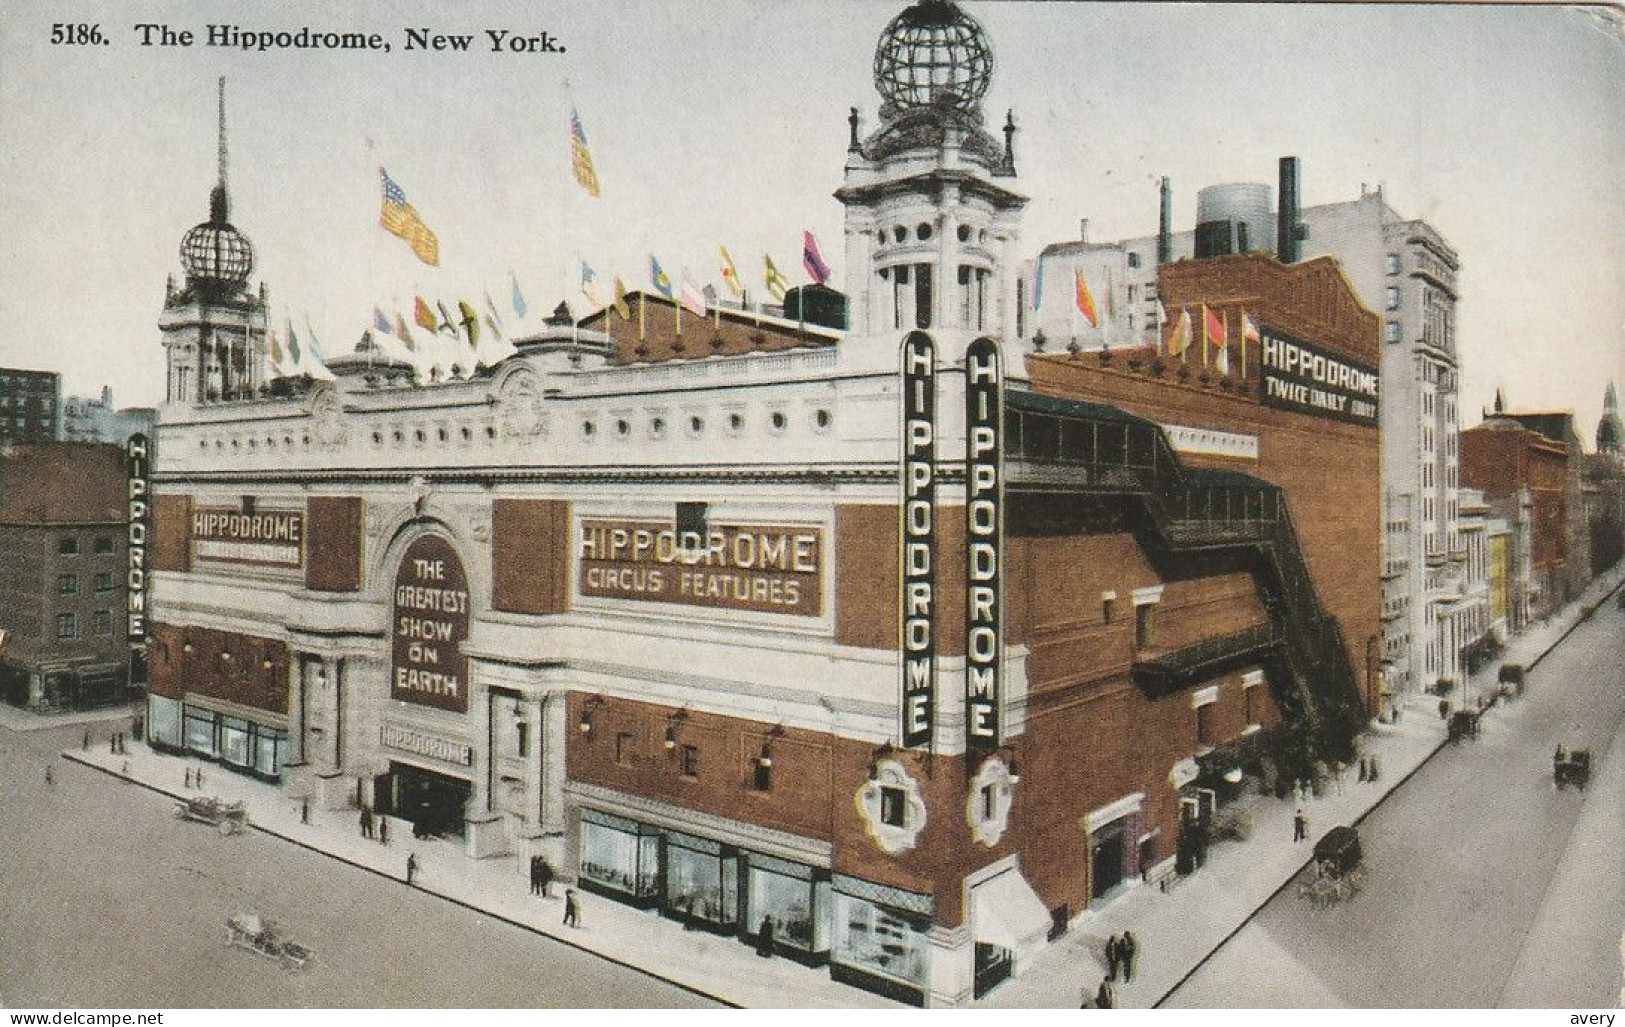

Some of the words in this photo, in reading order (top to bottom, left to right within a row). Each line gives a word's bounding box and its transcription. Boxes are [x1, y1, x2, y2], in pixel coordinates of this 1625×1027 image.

[50, 24, 110, 46] 5186.
[134, 23, 194, 46] The
[206, 24, 391, 51] Hippodrome,
[403, 28, 473, 51] New
[485, 29, 567, 53] York.
[1263, 336, 1379, 395] HIPPODROME
[1265, 376, 1309, 404] TWICE
[1310, 388, 1347, 411] DAILY
[129, 440, 146, 635] HIPPODROME
[193, 513, 300, 540] HIPPODROME
[906, 343, 932, 733] HIPPODROME
[579, 527, 816, 572] HIPPODROME
[968, 354, 996, 736] HIPPODROME
[413, 559, 444, 580] THE
[586, 567, 663, 592] CIRCUS
[680, 572, 800, 605] FEATURES
[397, 585, 467, 614] GREATEST
[399, 617, 453, 641] SHOW
[408, 645, 438, 663] ON
[397, 666, 457, 697] EARTH
